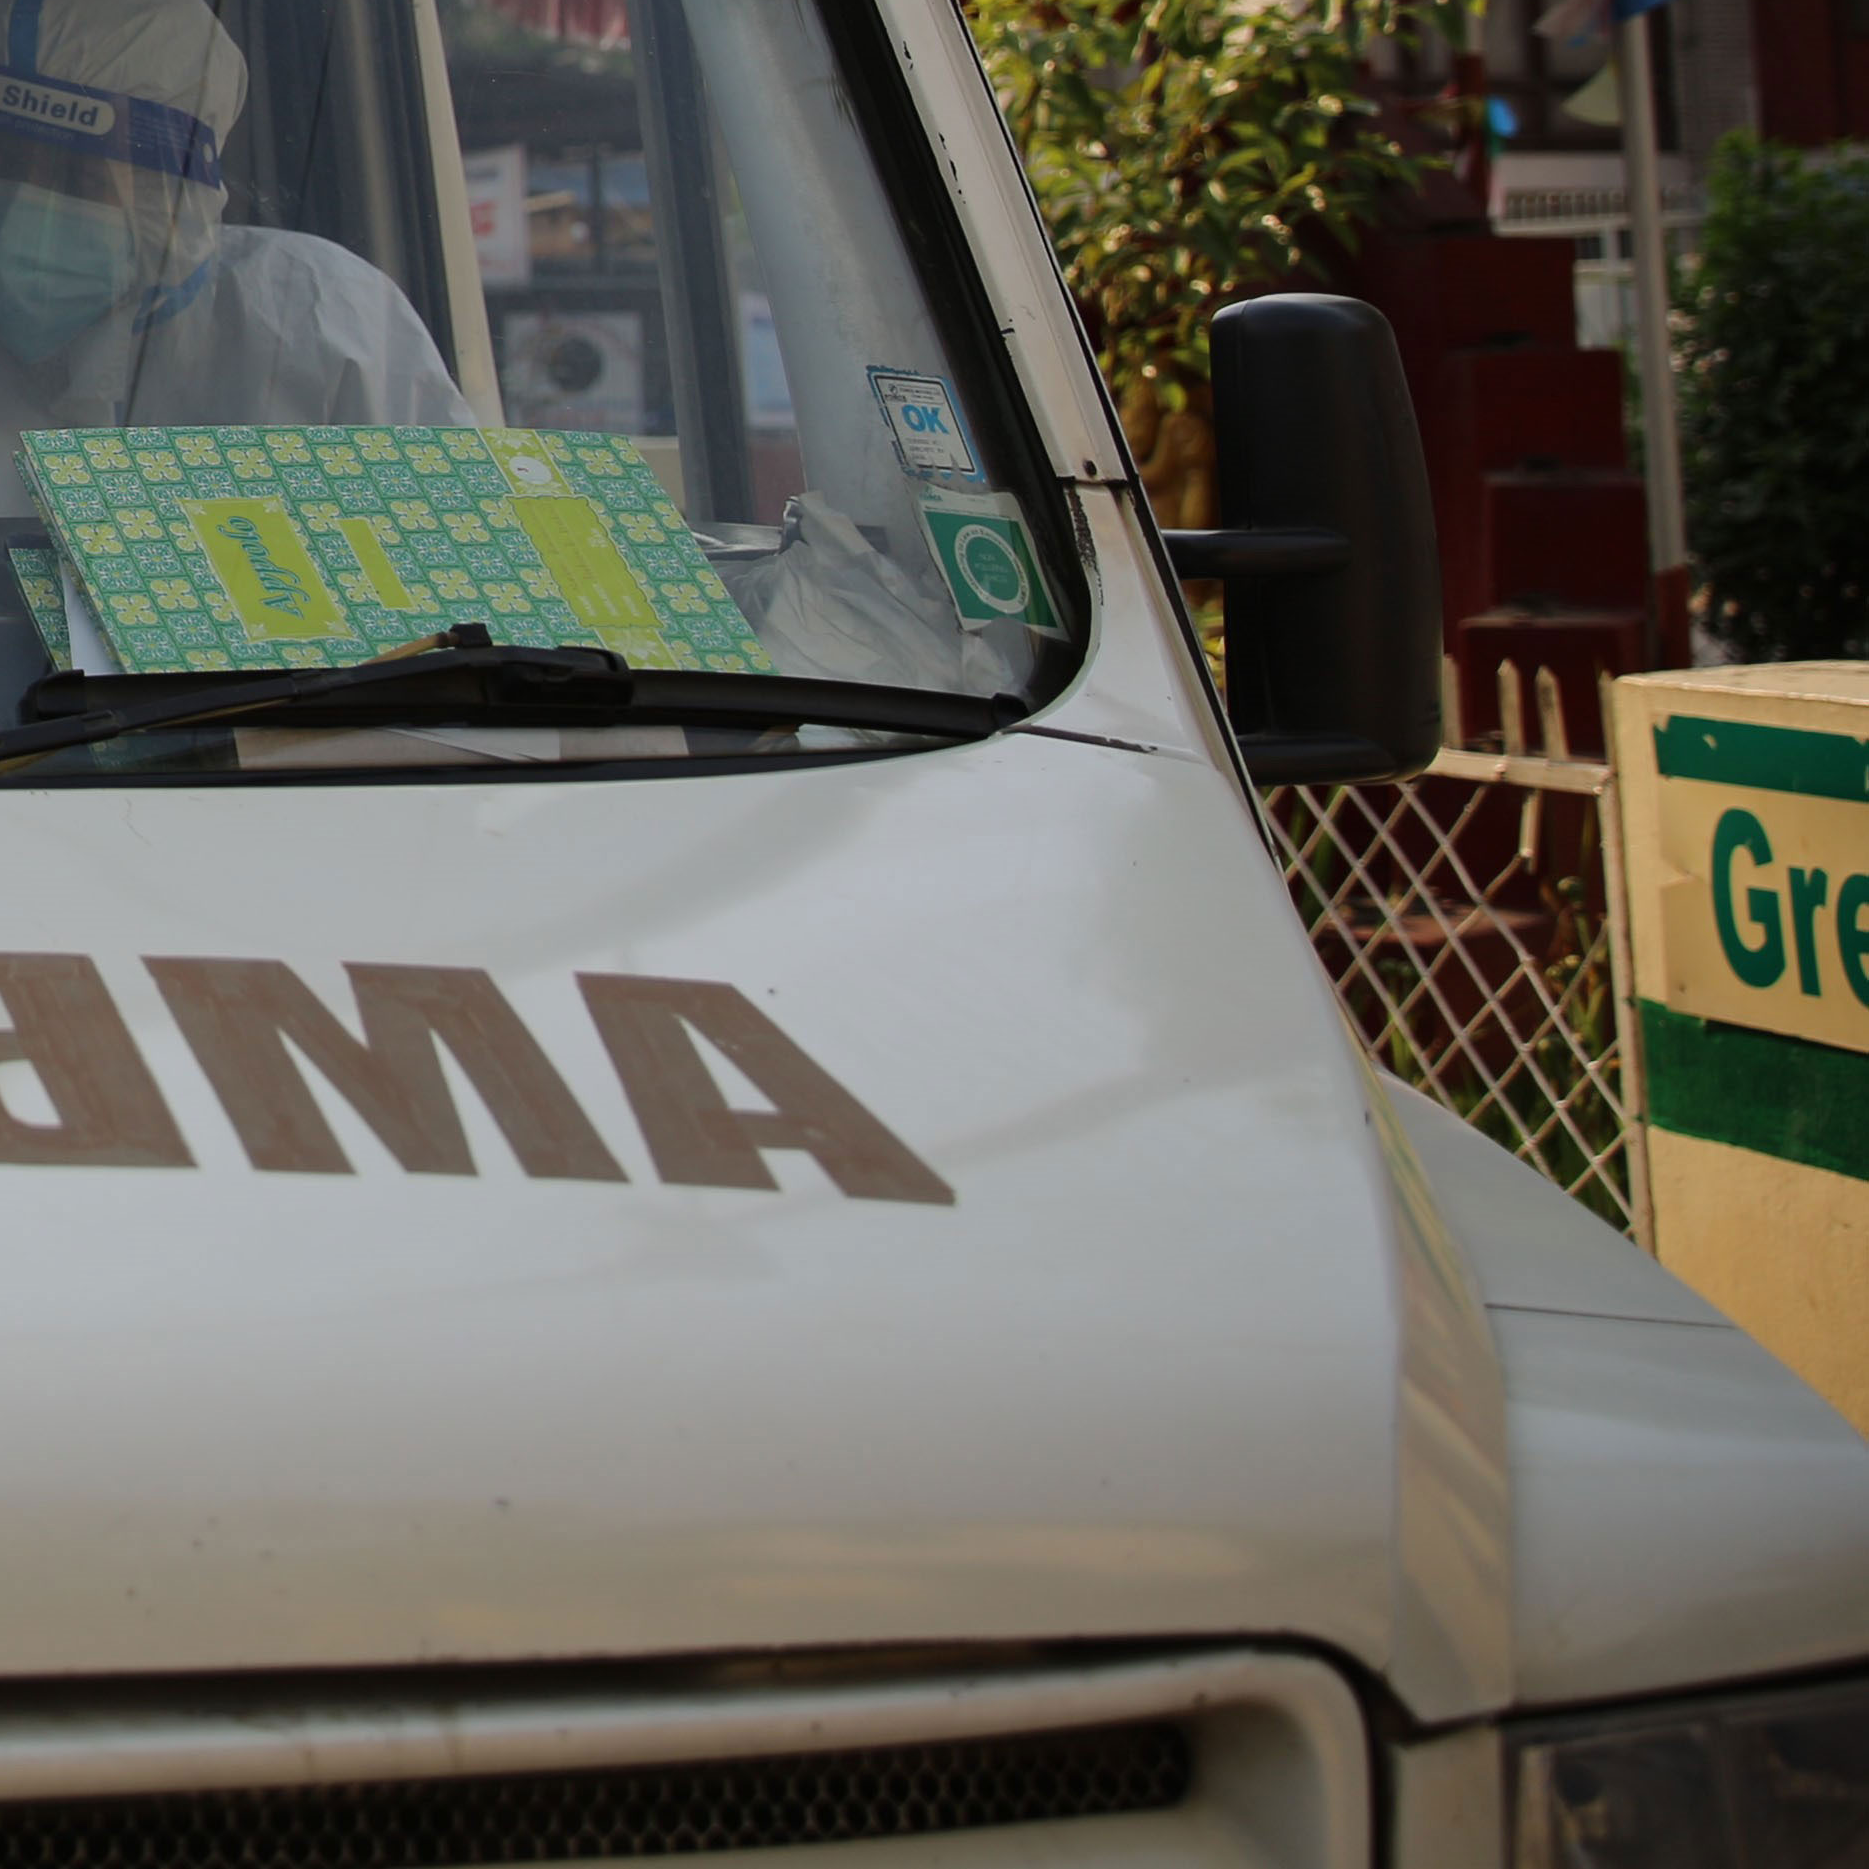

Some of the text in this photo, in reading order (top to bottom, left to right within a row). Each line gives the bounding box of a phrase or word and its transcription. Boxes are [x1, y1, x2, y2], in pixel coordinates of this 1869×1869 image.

[2, 83, 99, 128] Shield
[901, 403, 951, 435] OK
[215, 515, 312, 620] Appolo
